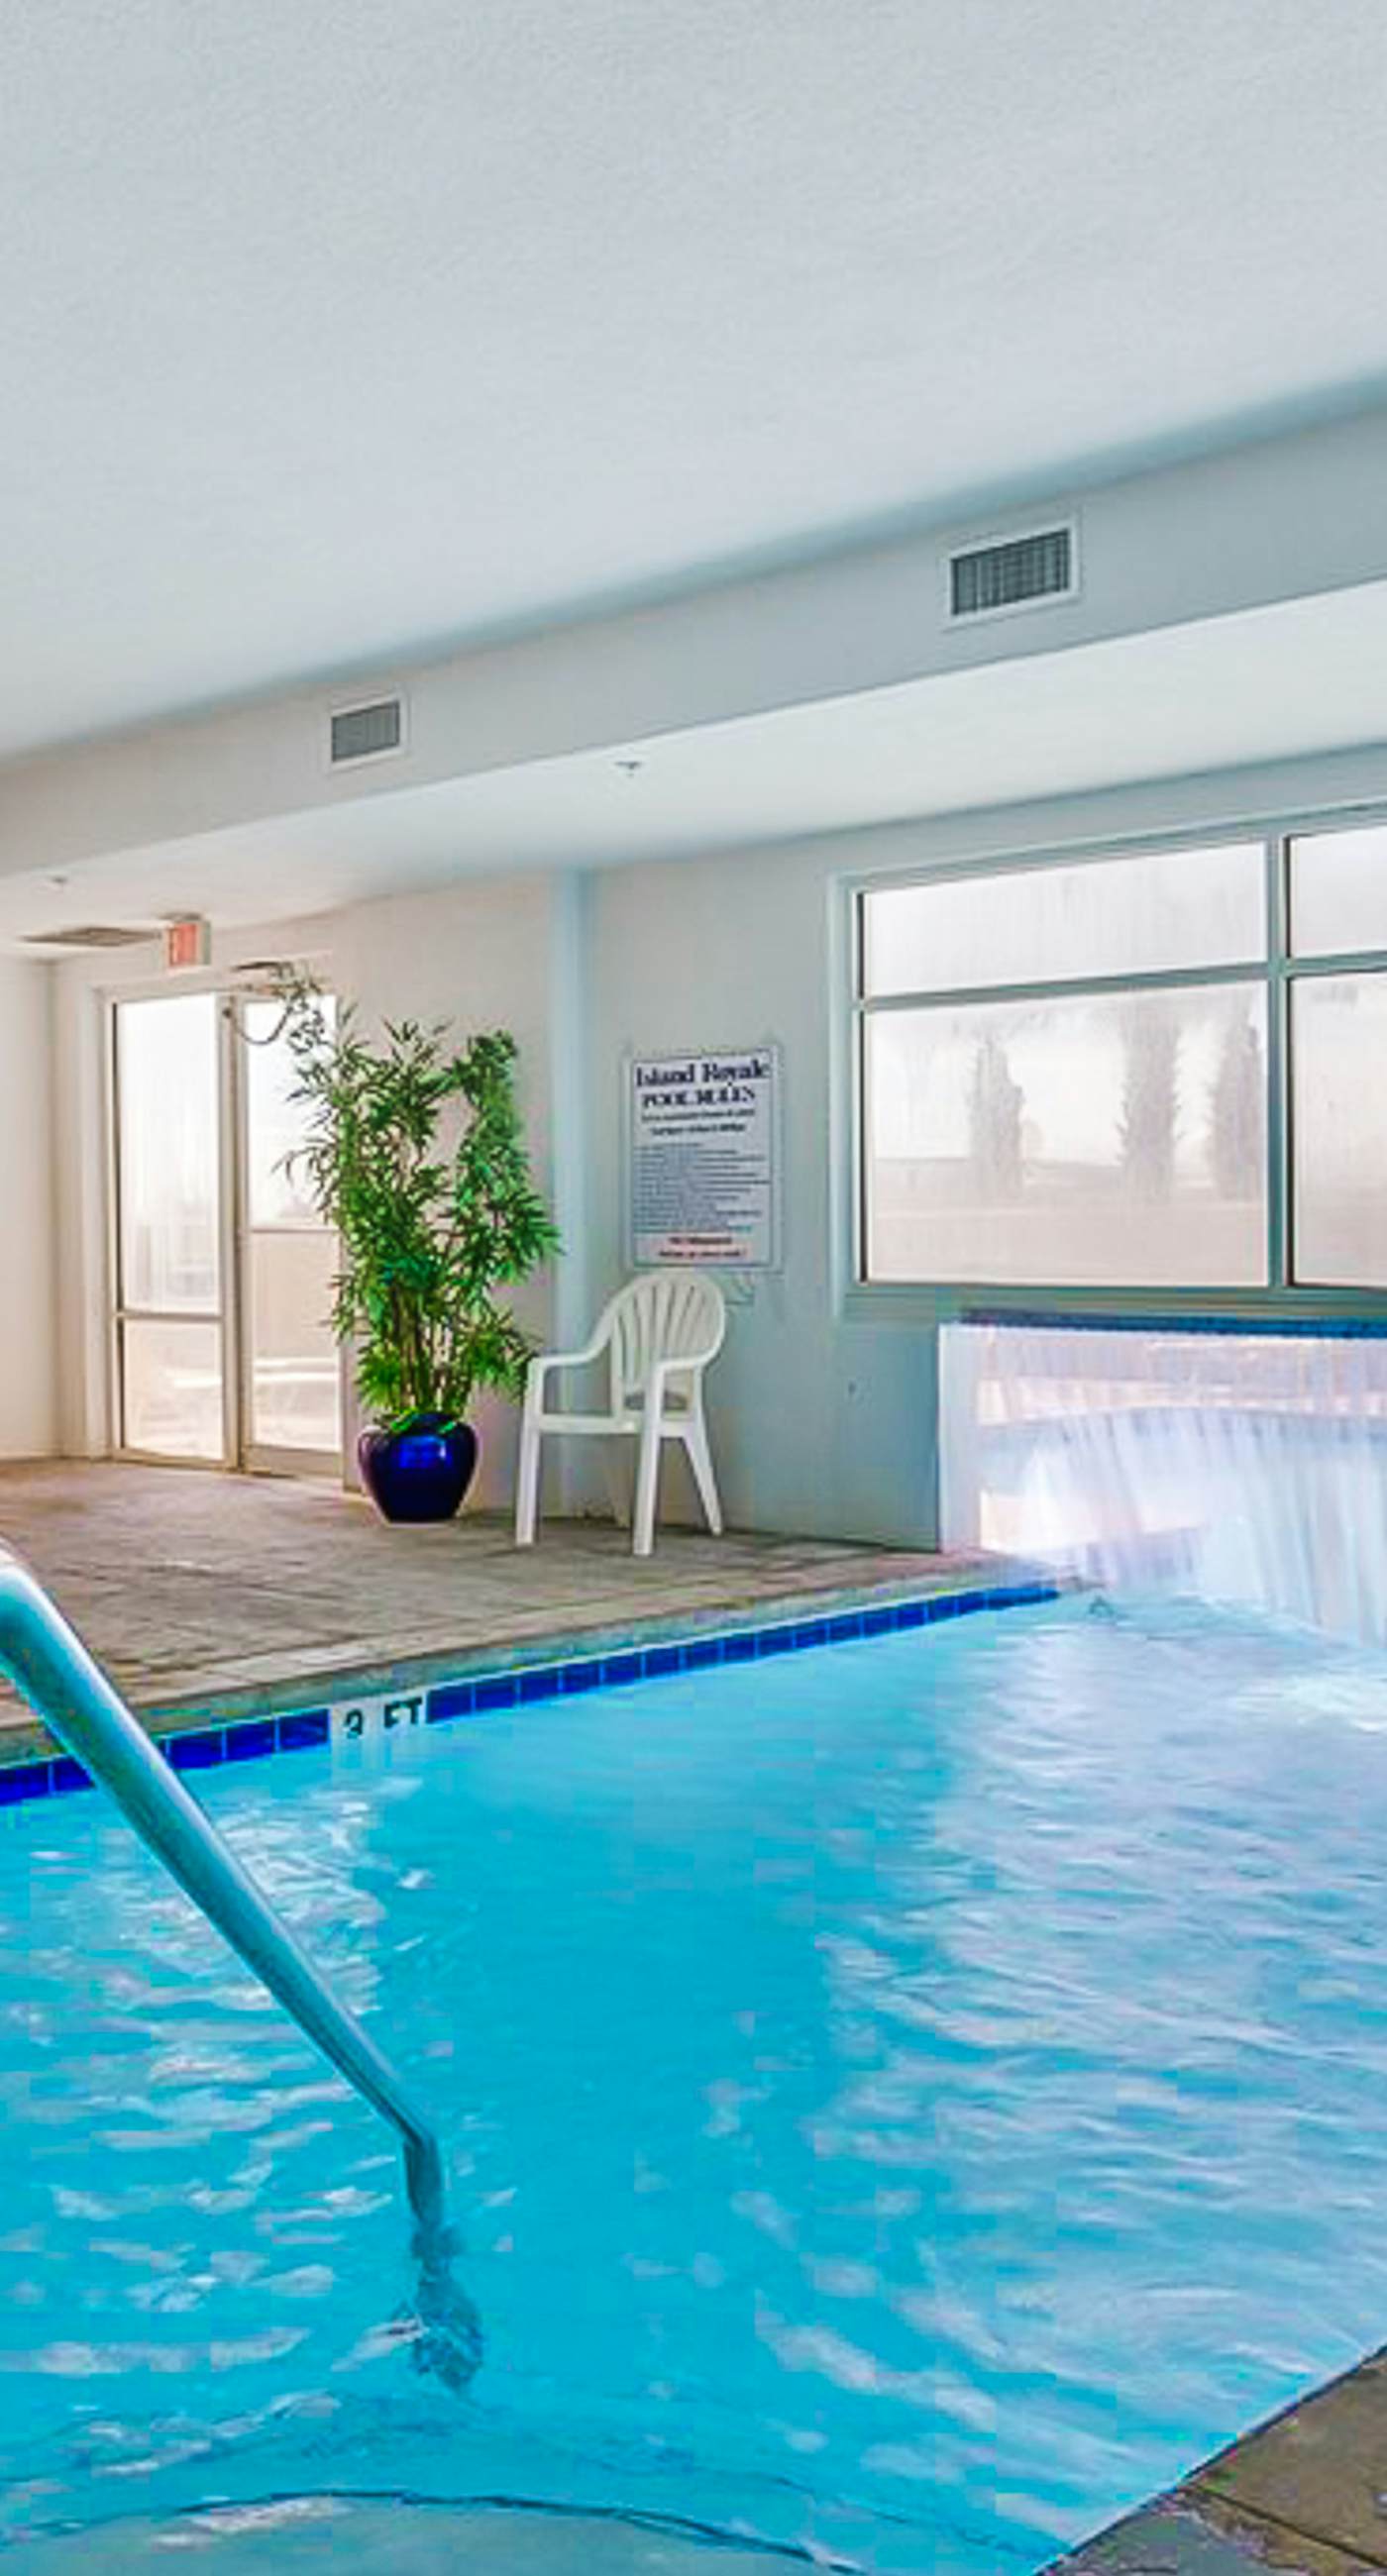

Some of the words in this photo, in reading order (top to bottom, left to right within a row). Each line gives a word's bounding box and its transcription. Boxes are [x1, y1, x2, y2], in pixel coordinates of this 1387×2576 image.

[637, 1063, 695, 1087] Island
[701, 1059, 771, 1082] Royale
[384, 1697, 423, 1729] FT
